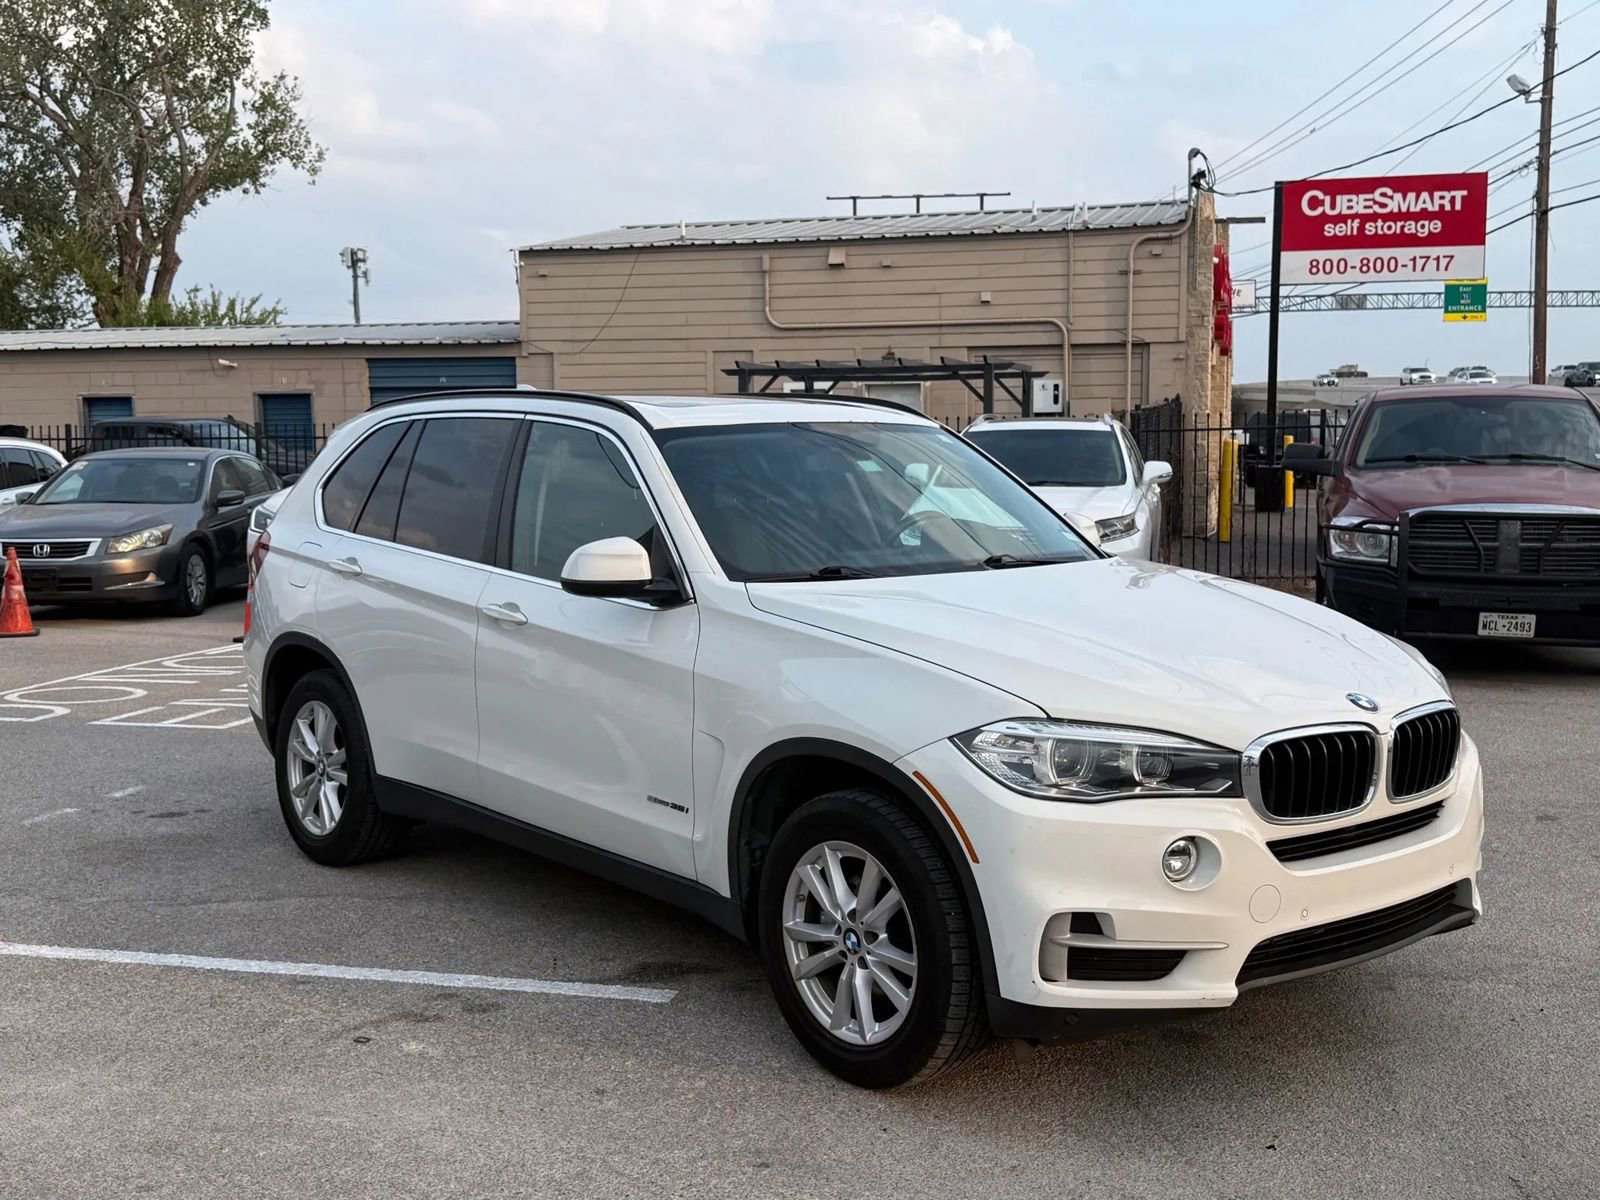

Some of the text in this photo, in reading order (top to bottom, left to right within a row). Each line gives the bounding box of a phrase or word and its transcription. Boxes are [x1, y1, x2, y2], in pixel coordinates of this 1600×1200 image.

[1323, 218, 1442, 238] self storage
[1308, 254, 1455, 276] 800-800-1717
[1448, 304, 1482, 312] ENTRANCE
